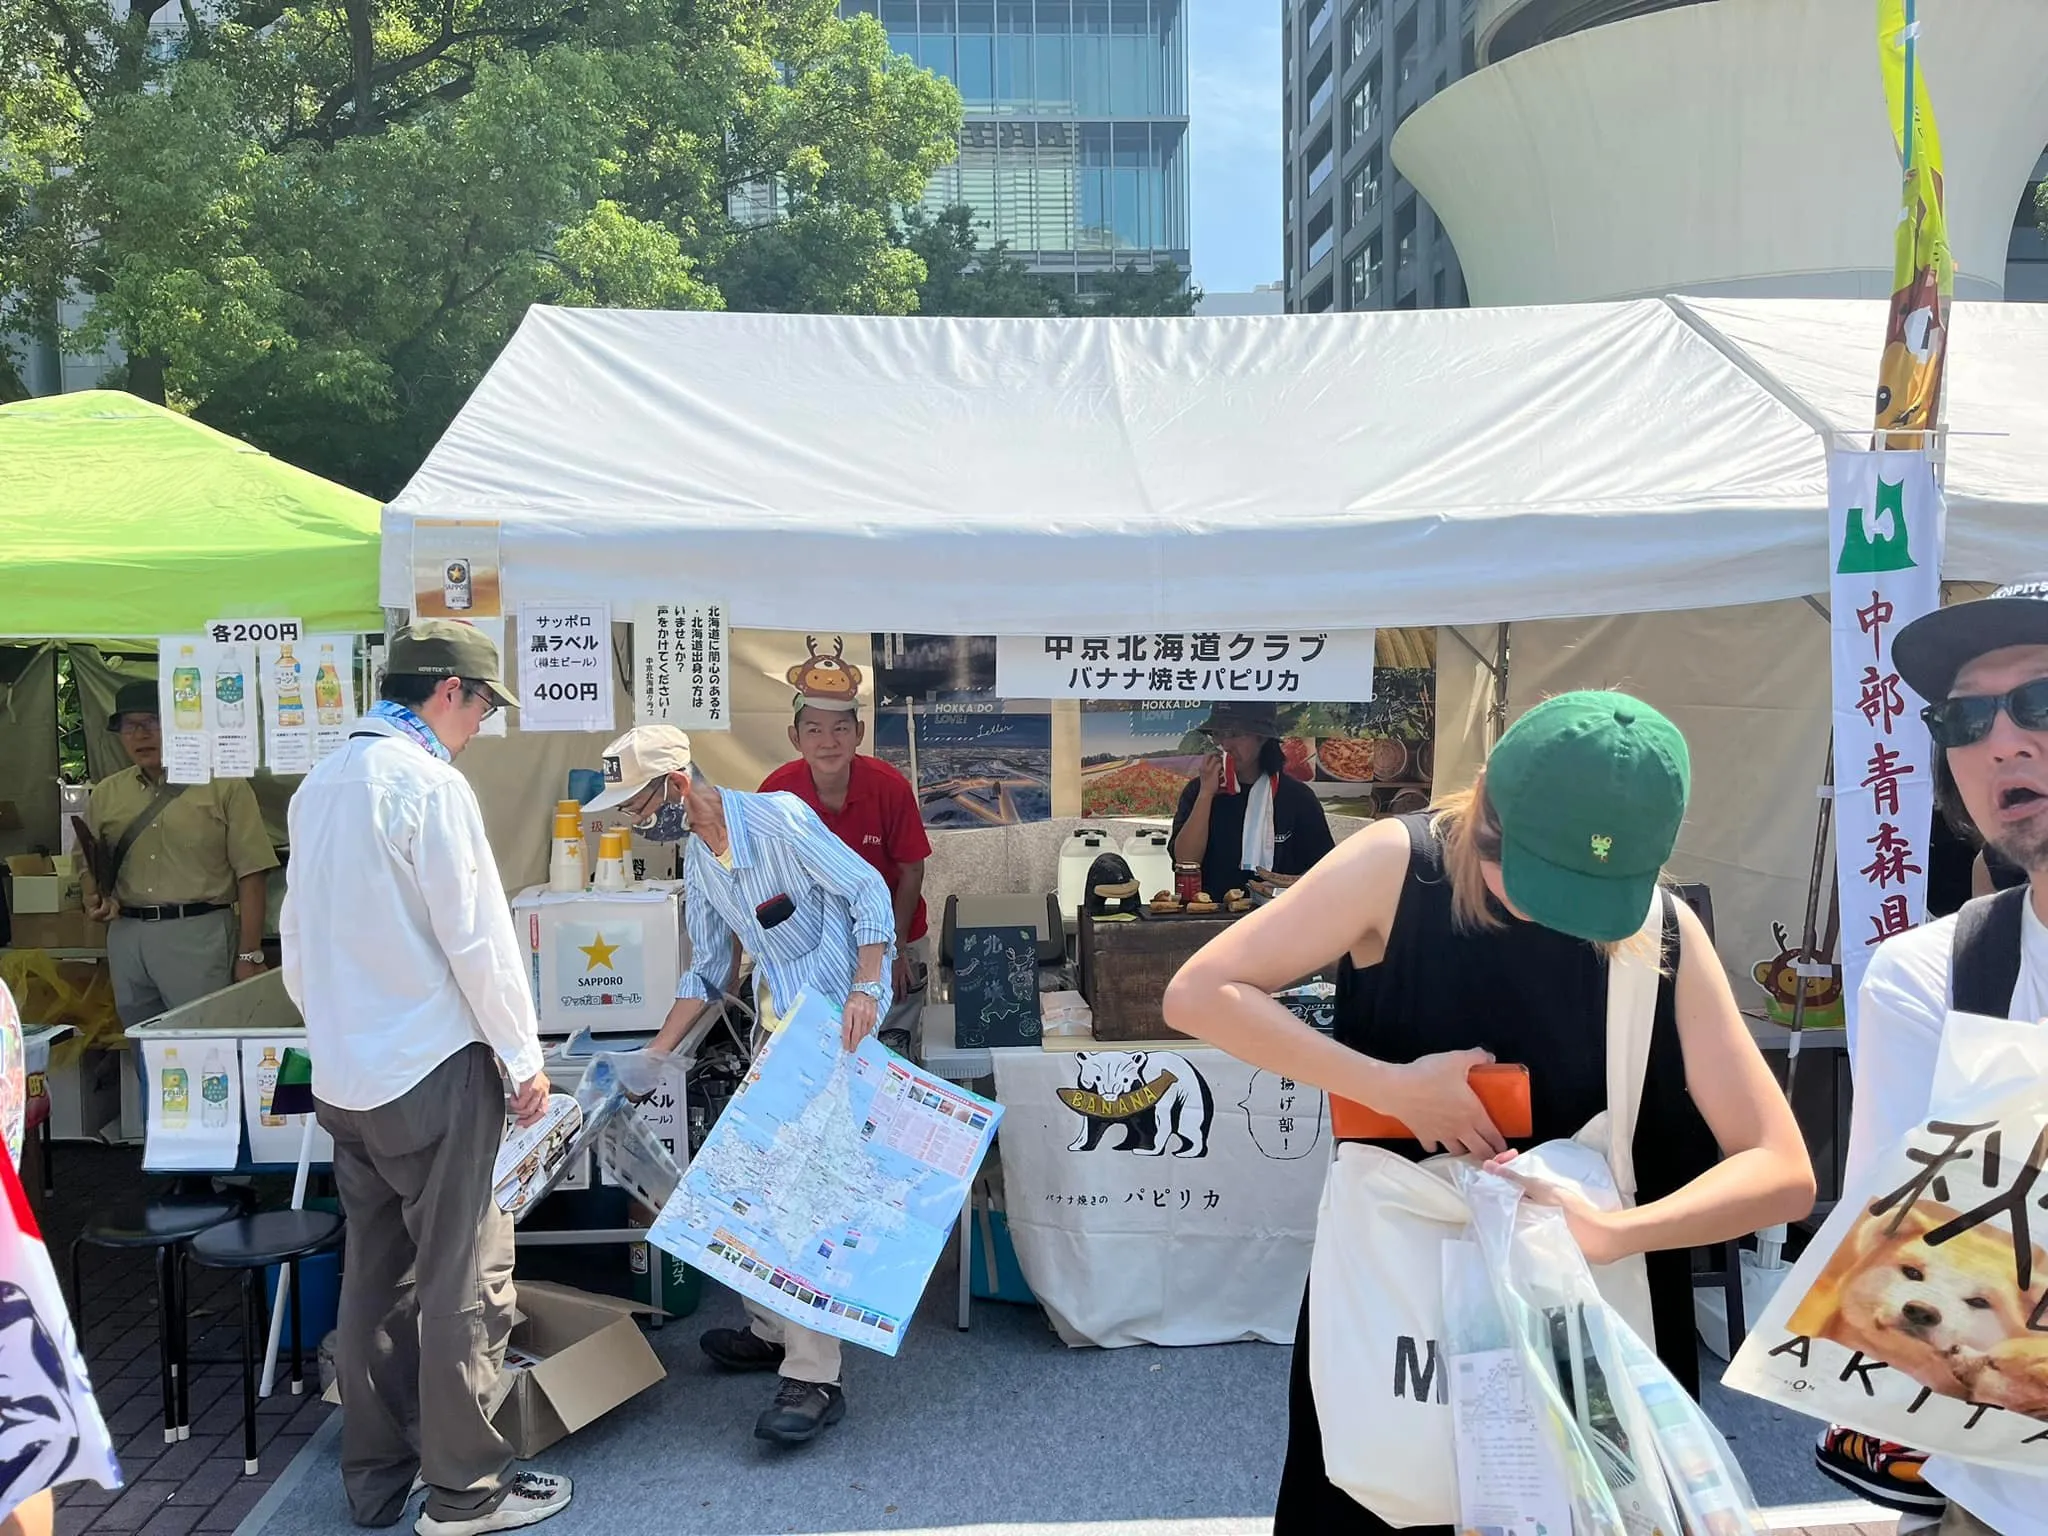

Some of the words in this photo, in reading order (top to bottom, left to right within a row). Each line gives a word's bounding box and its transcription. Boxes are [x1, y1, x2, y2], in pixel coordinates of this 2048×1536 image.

[211, 622, 299, 644] 各200円
[536, 614, 592, 629] サッポロ
[530, 634, 599, 653] 黒ラベル
[674, 605, 687, 673] いませんか？
[1044, 632, 1329, 663] 中京北海道クラブ
[708, 605, 721, 720] 北海道に関心のある方
[1067, 666, 1301, 693] バナナ焼きパピリカ
[533, 681, 599, 702] 400円
[935, 703, 994, 714] HOKKADO
[1141, 699, 1201, 710] HOKKADO
[1856, 590, 1922, 946] 中部青森県
[577, 976, 624, 987] SAPPORO
[1071, 1085, 1158, 1116] BANANA
[1045, 1193, 1109, 1207] バナナ焼きの
[1123, 1187, 1221, 1211] パピリカ
